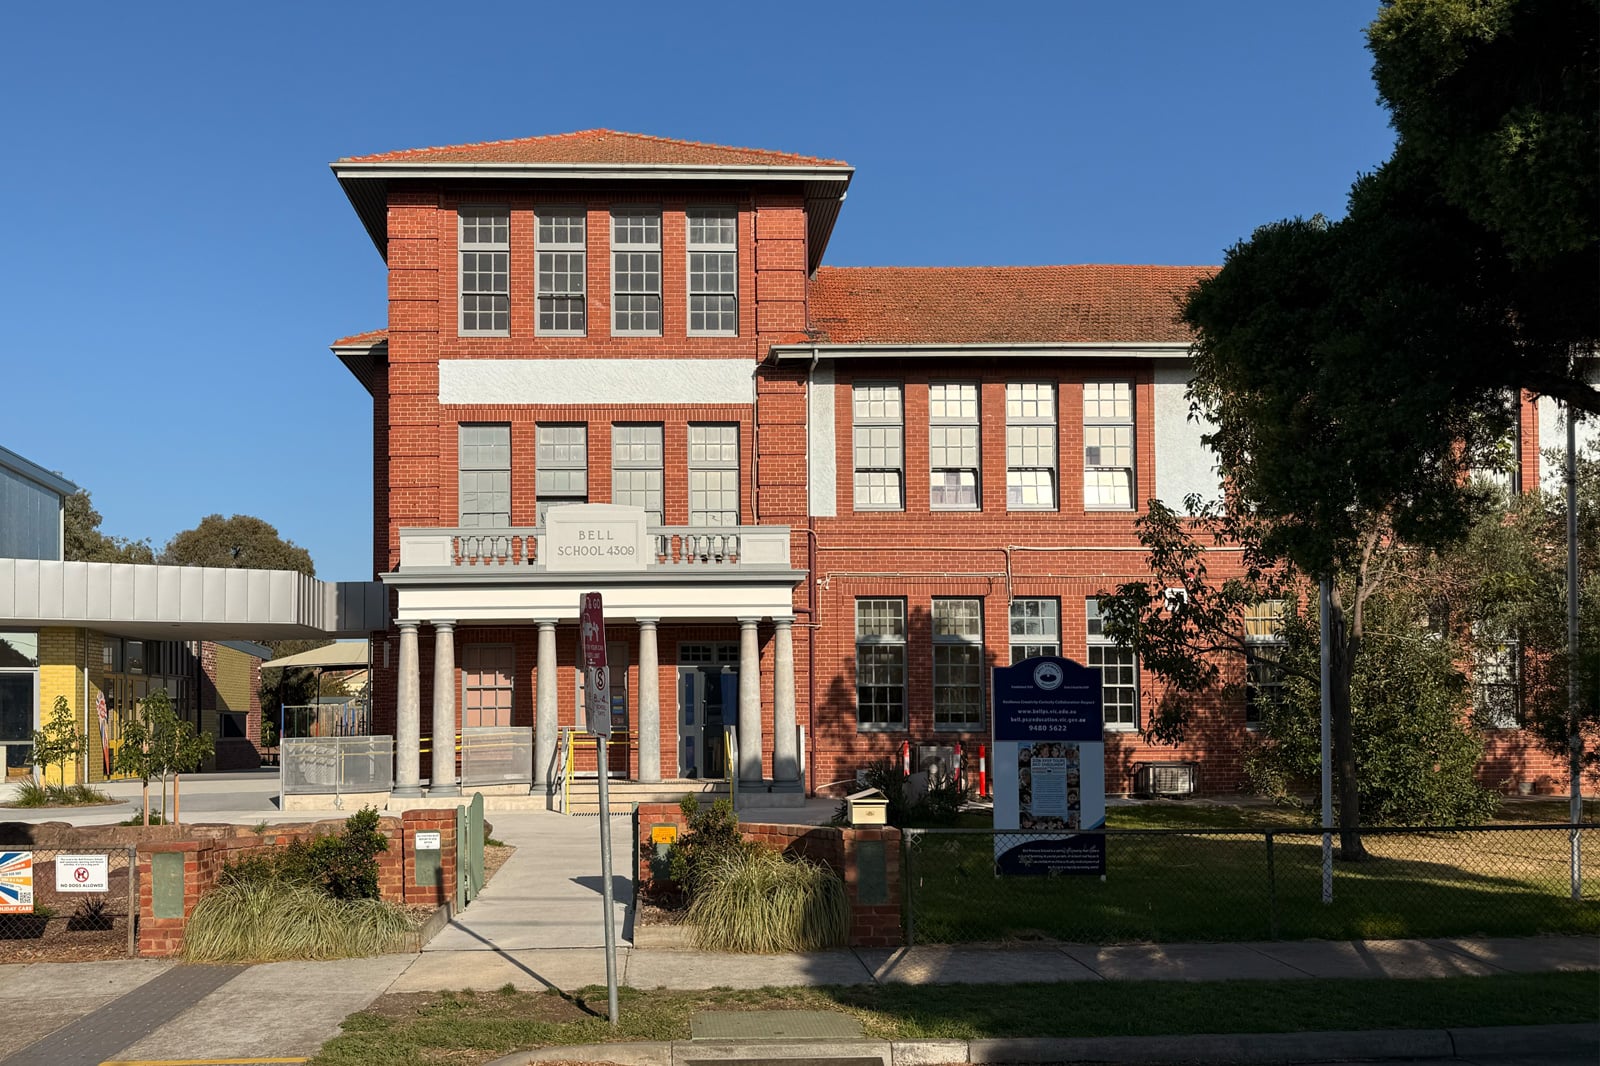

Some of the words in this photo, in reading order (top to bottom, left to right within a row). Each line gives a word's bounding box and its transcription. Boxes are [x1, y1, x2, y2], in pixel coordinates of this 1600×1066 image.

[578, 530, 614, 540] BELL
[557, 545, 604, 556] SCHOOL
[606, 545, 635, 556] 4309
[592, 598, 601, 609] GO
